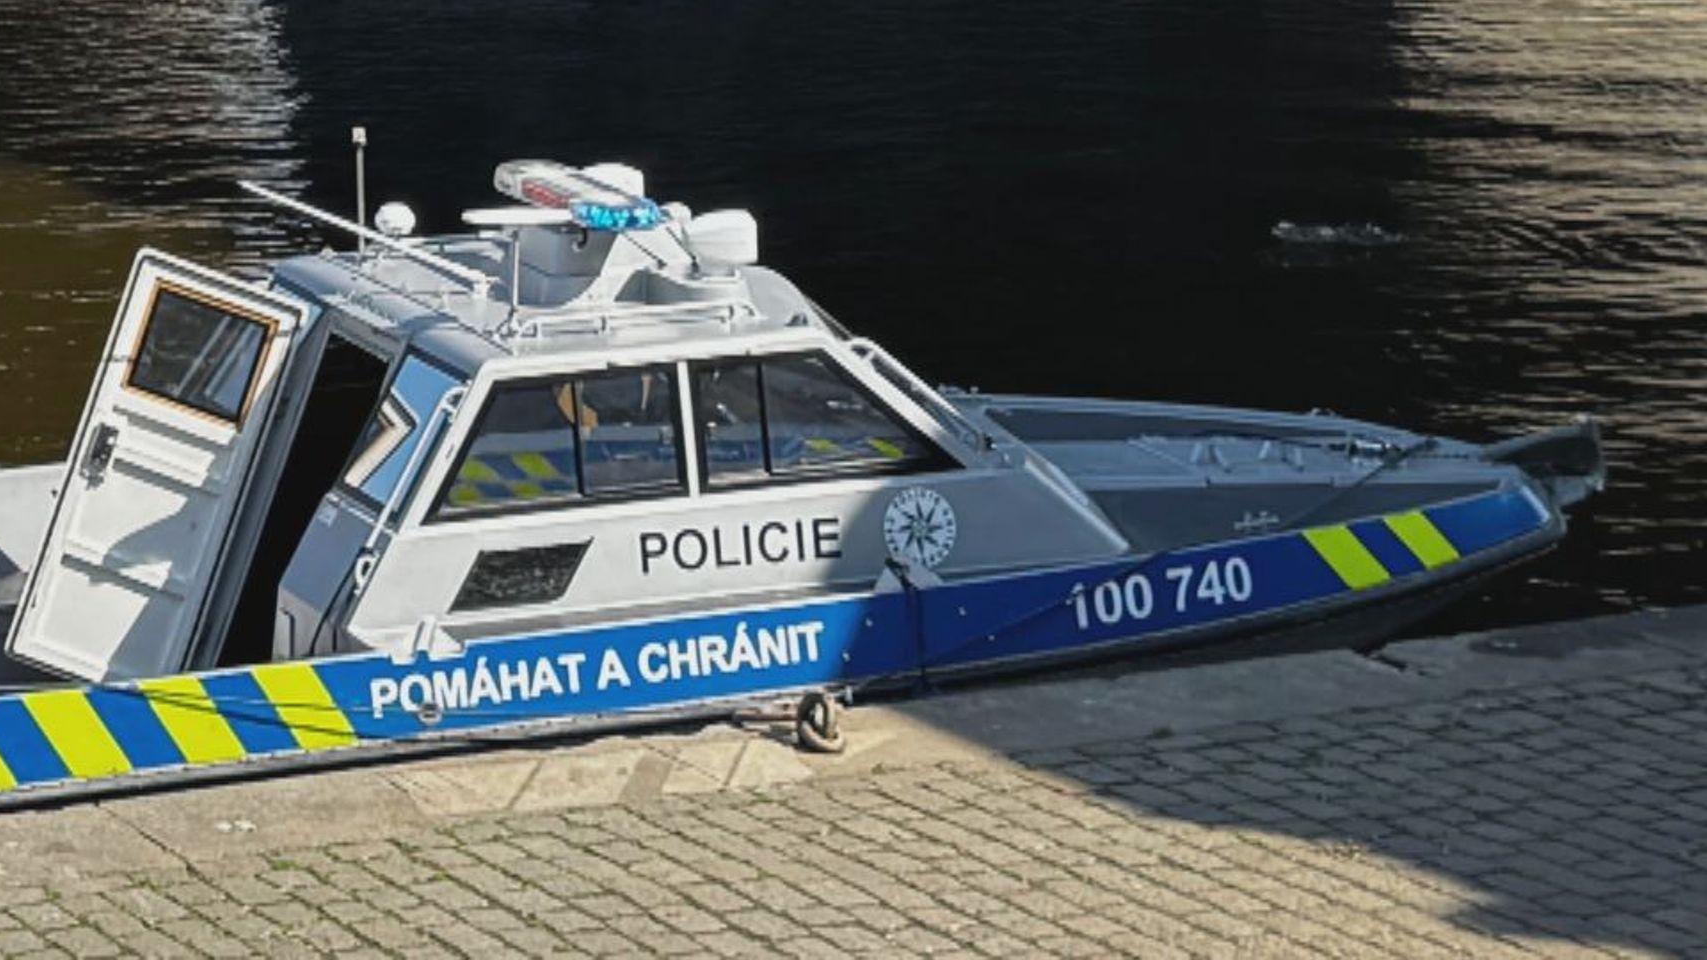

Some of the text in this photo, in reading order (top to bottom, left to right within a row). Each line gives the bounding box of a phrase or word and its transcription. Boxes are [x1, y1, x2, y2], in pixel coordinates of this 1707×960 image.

[640, 518, 842, 573] POLICIE
[1068, 557, 1254, 630] 100 740
[370, 620, 825, 719] POMÁHAT A CHRÁNIT
